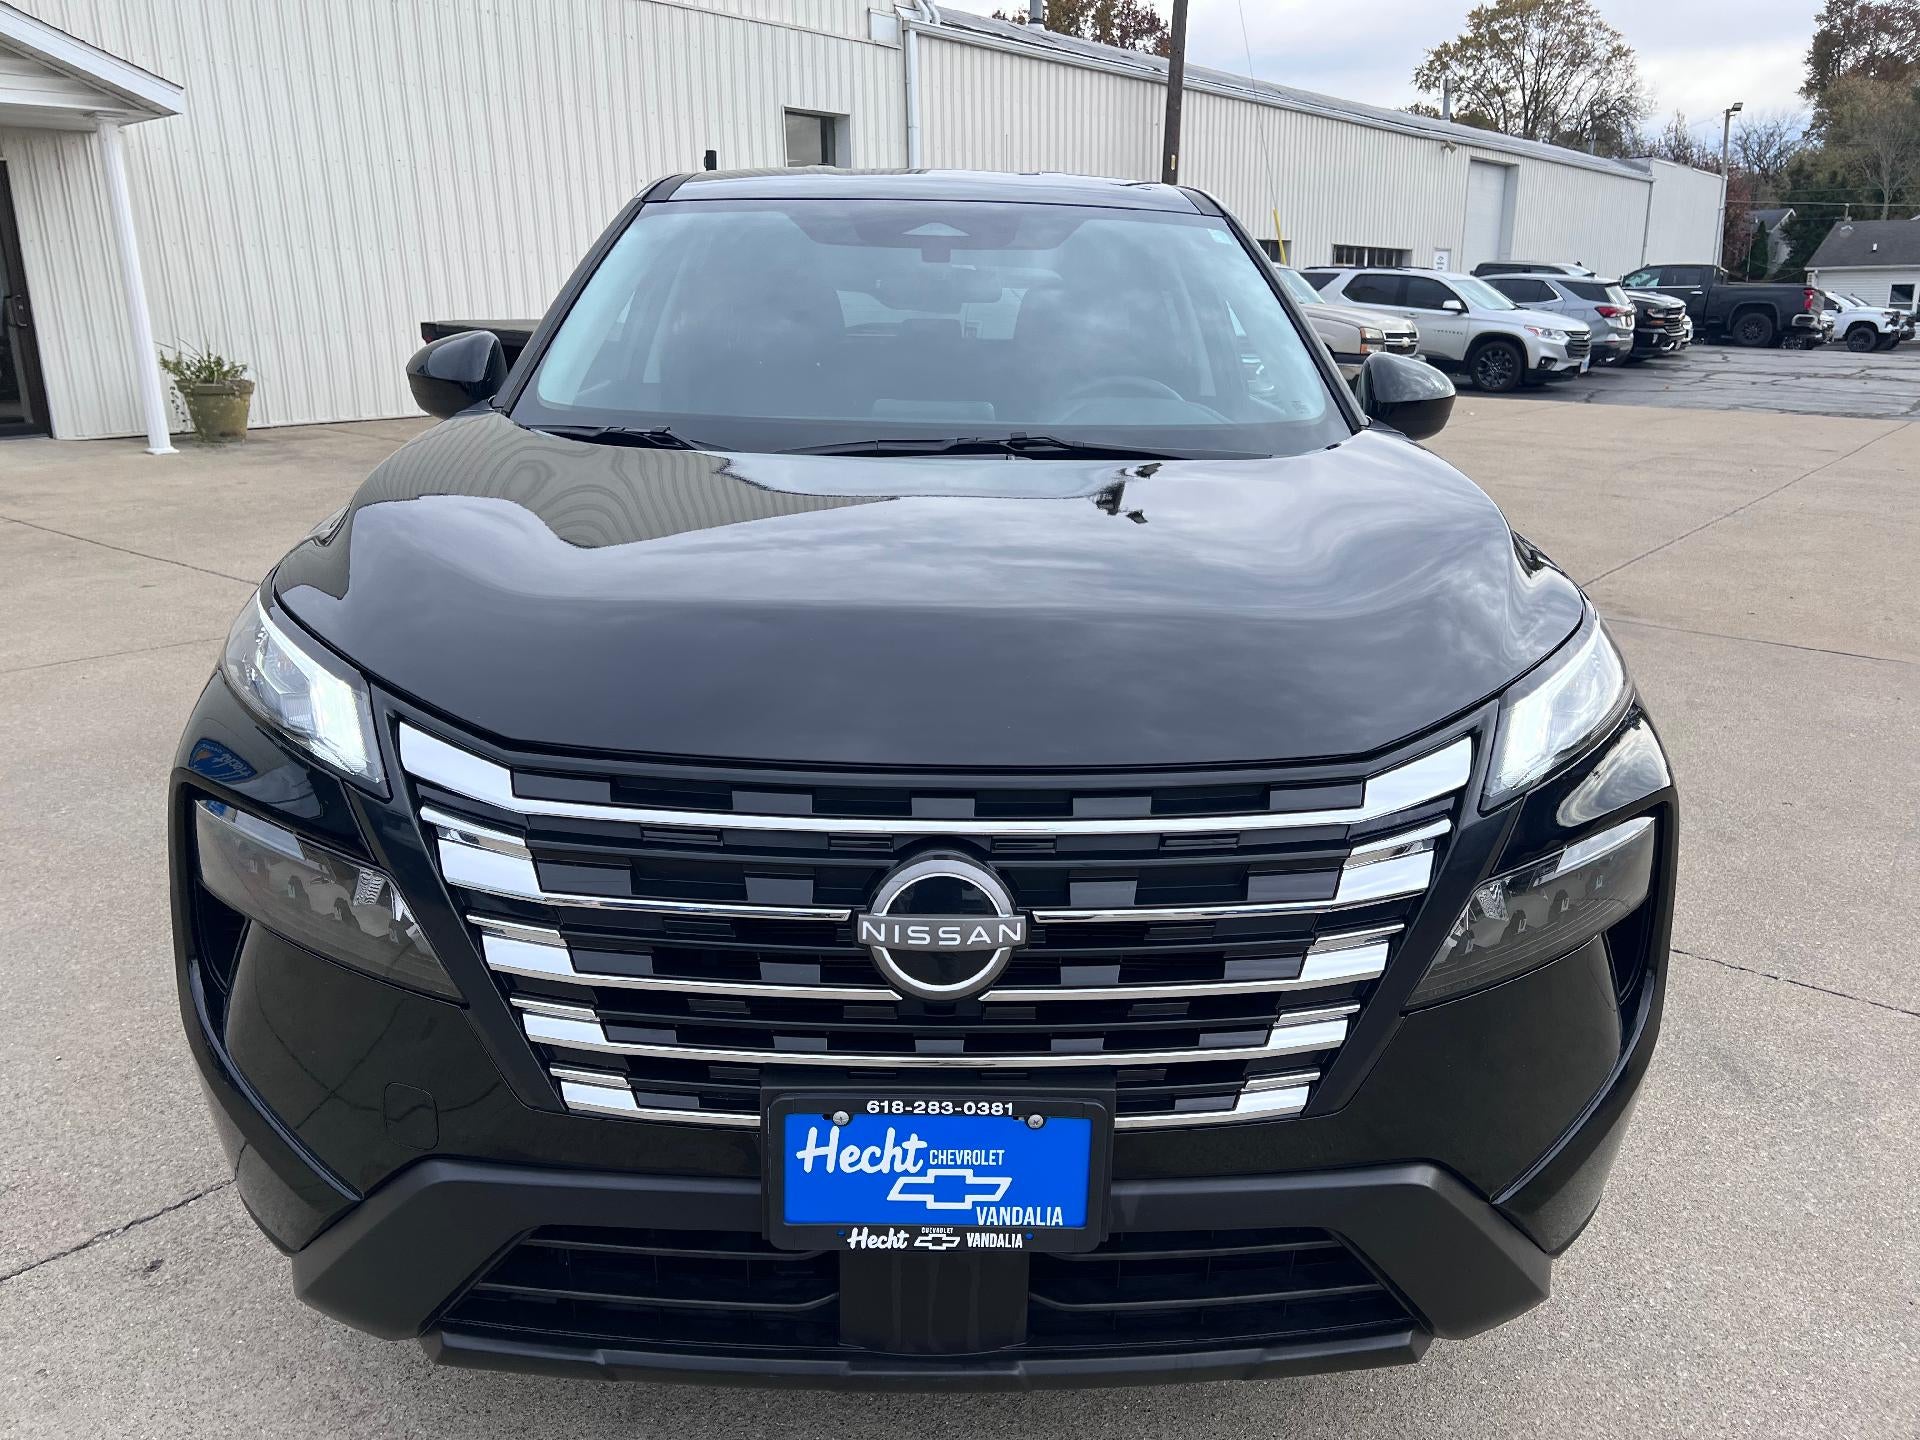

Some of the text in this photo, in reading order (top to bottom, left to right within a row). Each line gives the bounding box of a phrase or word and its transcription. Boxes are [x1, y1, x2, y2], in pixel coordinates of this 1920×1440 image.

[861, 921, 1021, 945] NISSAN
[866, 1100, 1014, 1116] 618-283-0381
[796, 1127, 1005, 1173] Hecht CHEVROLET
[976, 1206, 1063, 1226] VANDALIA
[847, 1227, 909, 1250] Hecht
[966, 1232, 1023, 1249] VANDALIA
